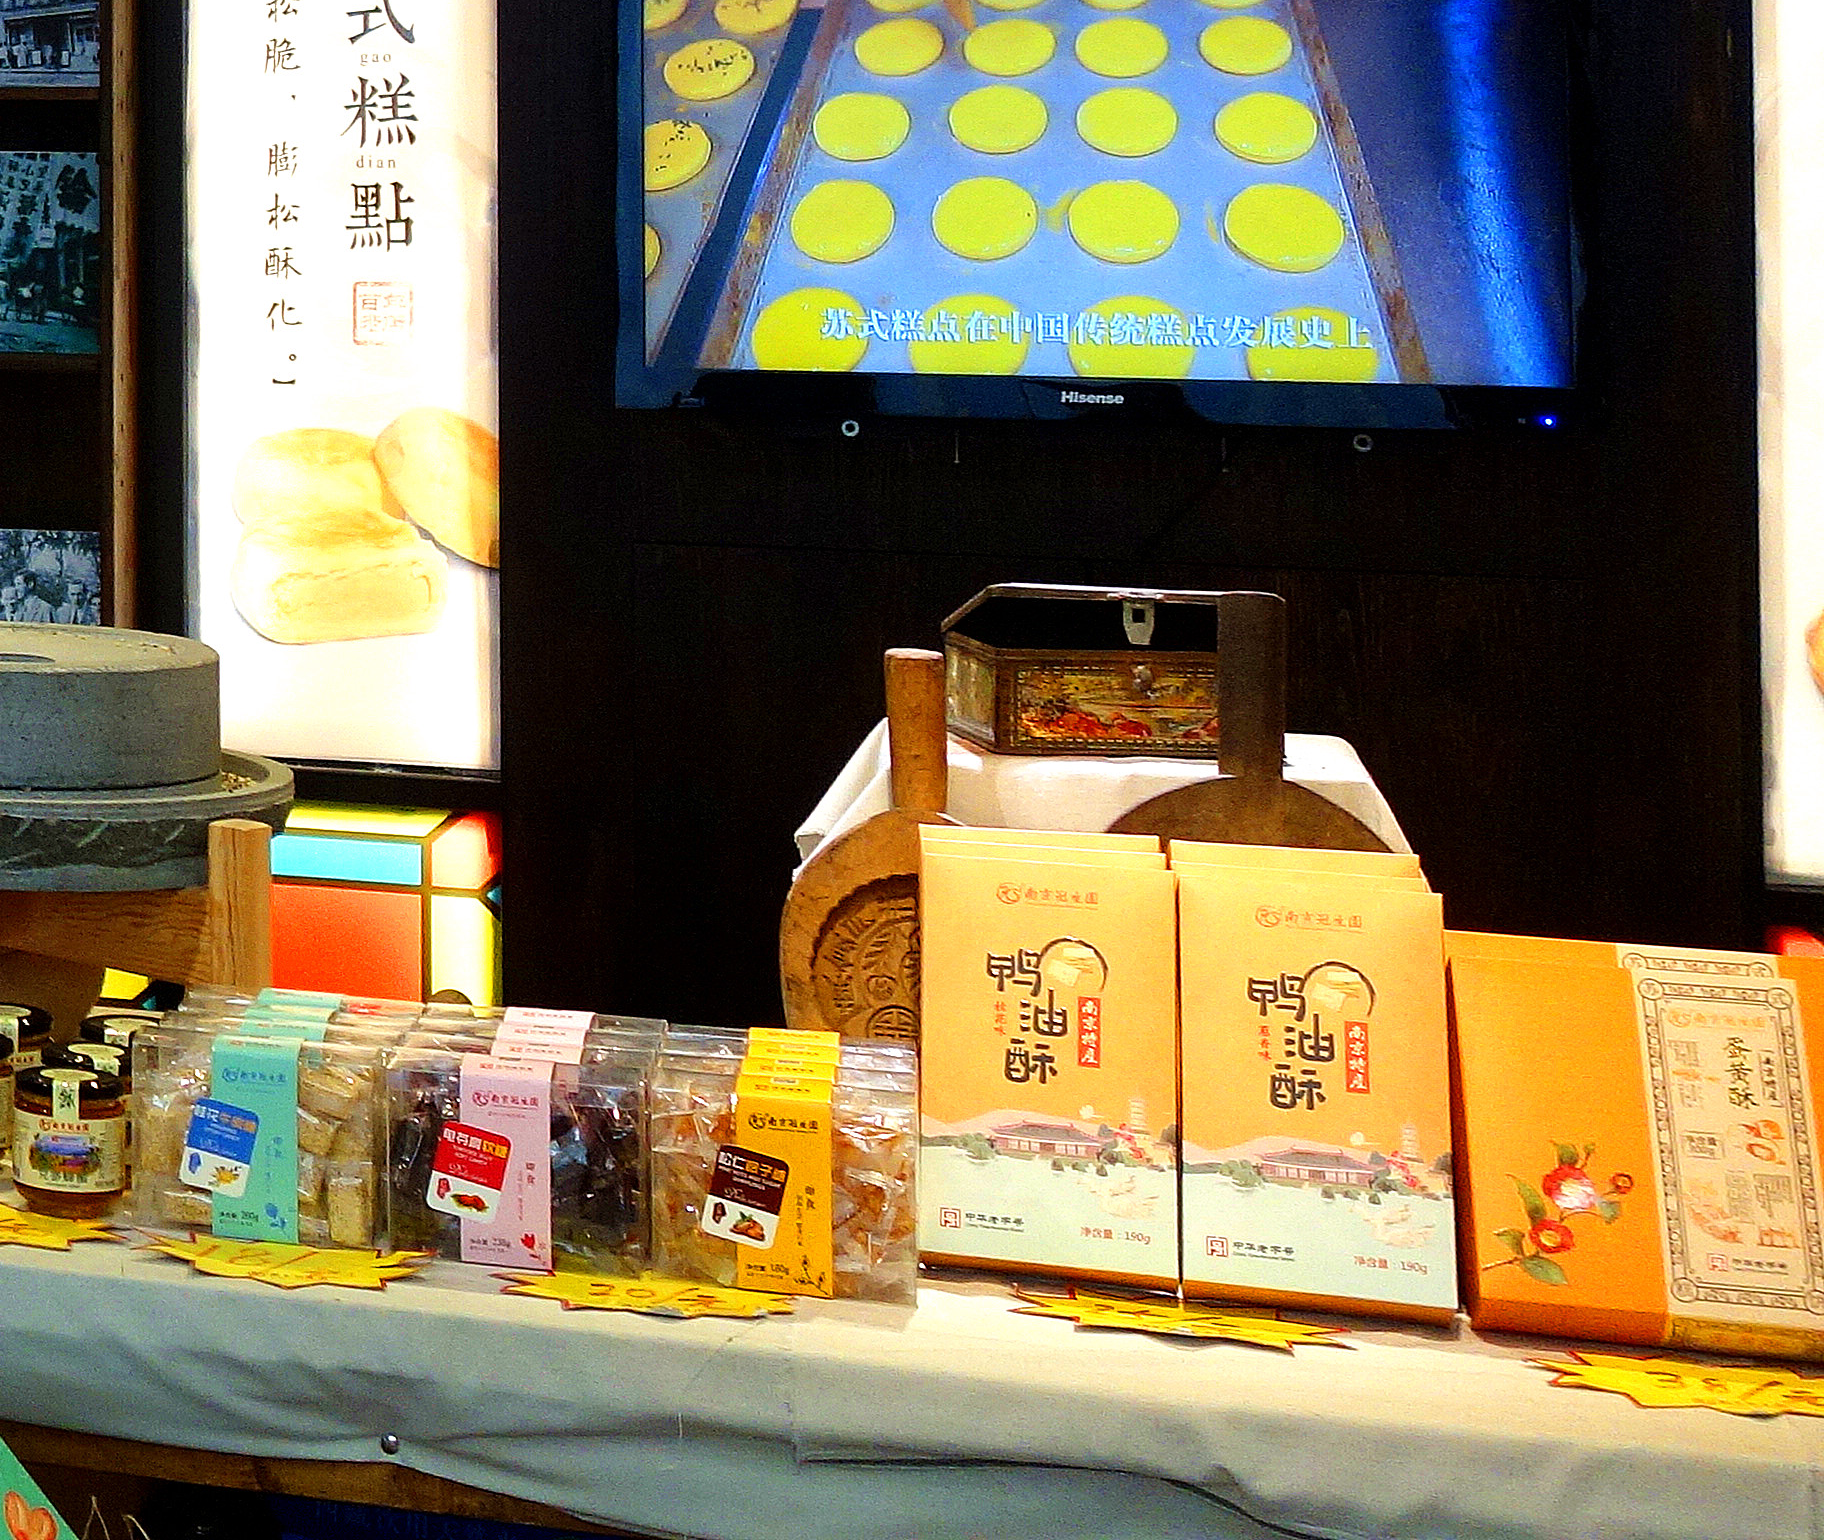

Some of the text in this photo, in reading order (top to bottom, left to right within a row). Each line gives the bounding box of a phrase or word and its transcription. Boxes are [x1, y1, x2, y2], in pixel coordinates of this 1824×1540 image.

[360, 51, 393, 67] gao
[355, 154, 398, 170] dian
[820, 307, 1374, 350] 苏式糕点在中国传统糕点发展史上
[1060, 389, 1125, 406] Hisense
[986, 948, 1069, 1086] 鸭油酥
[1247, 972, 1335, 1111] 鸭油酥
[1723, 1036, 1760, 1110] 蛋黄酥
